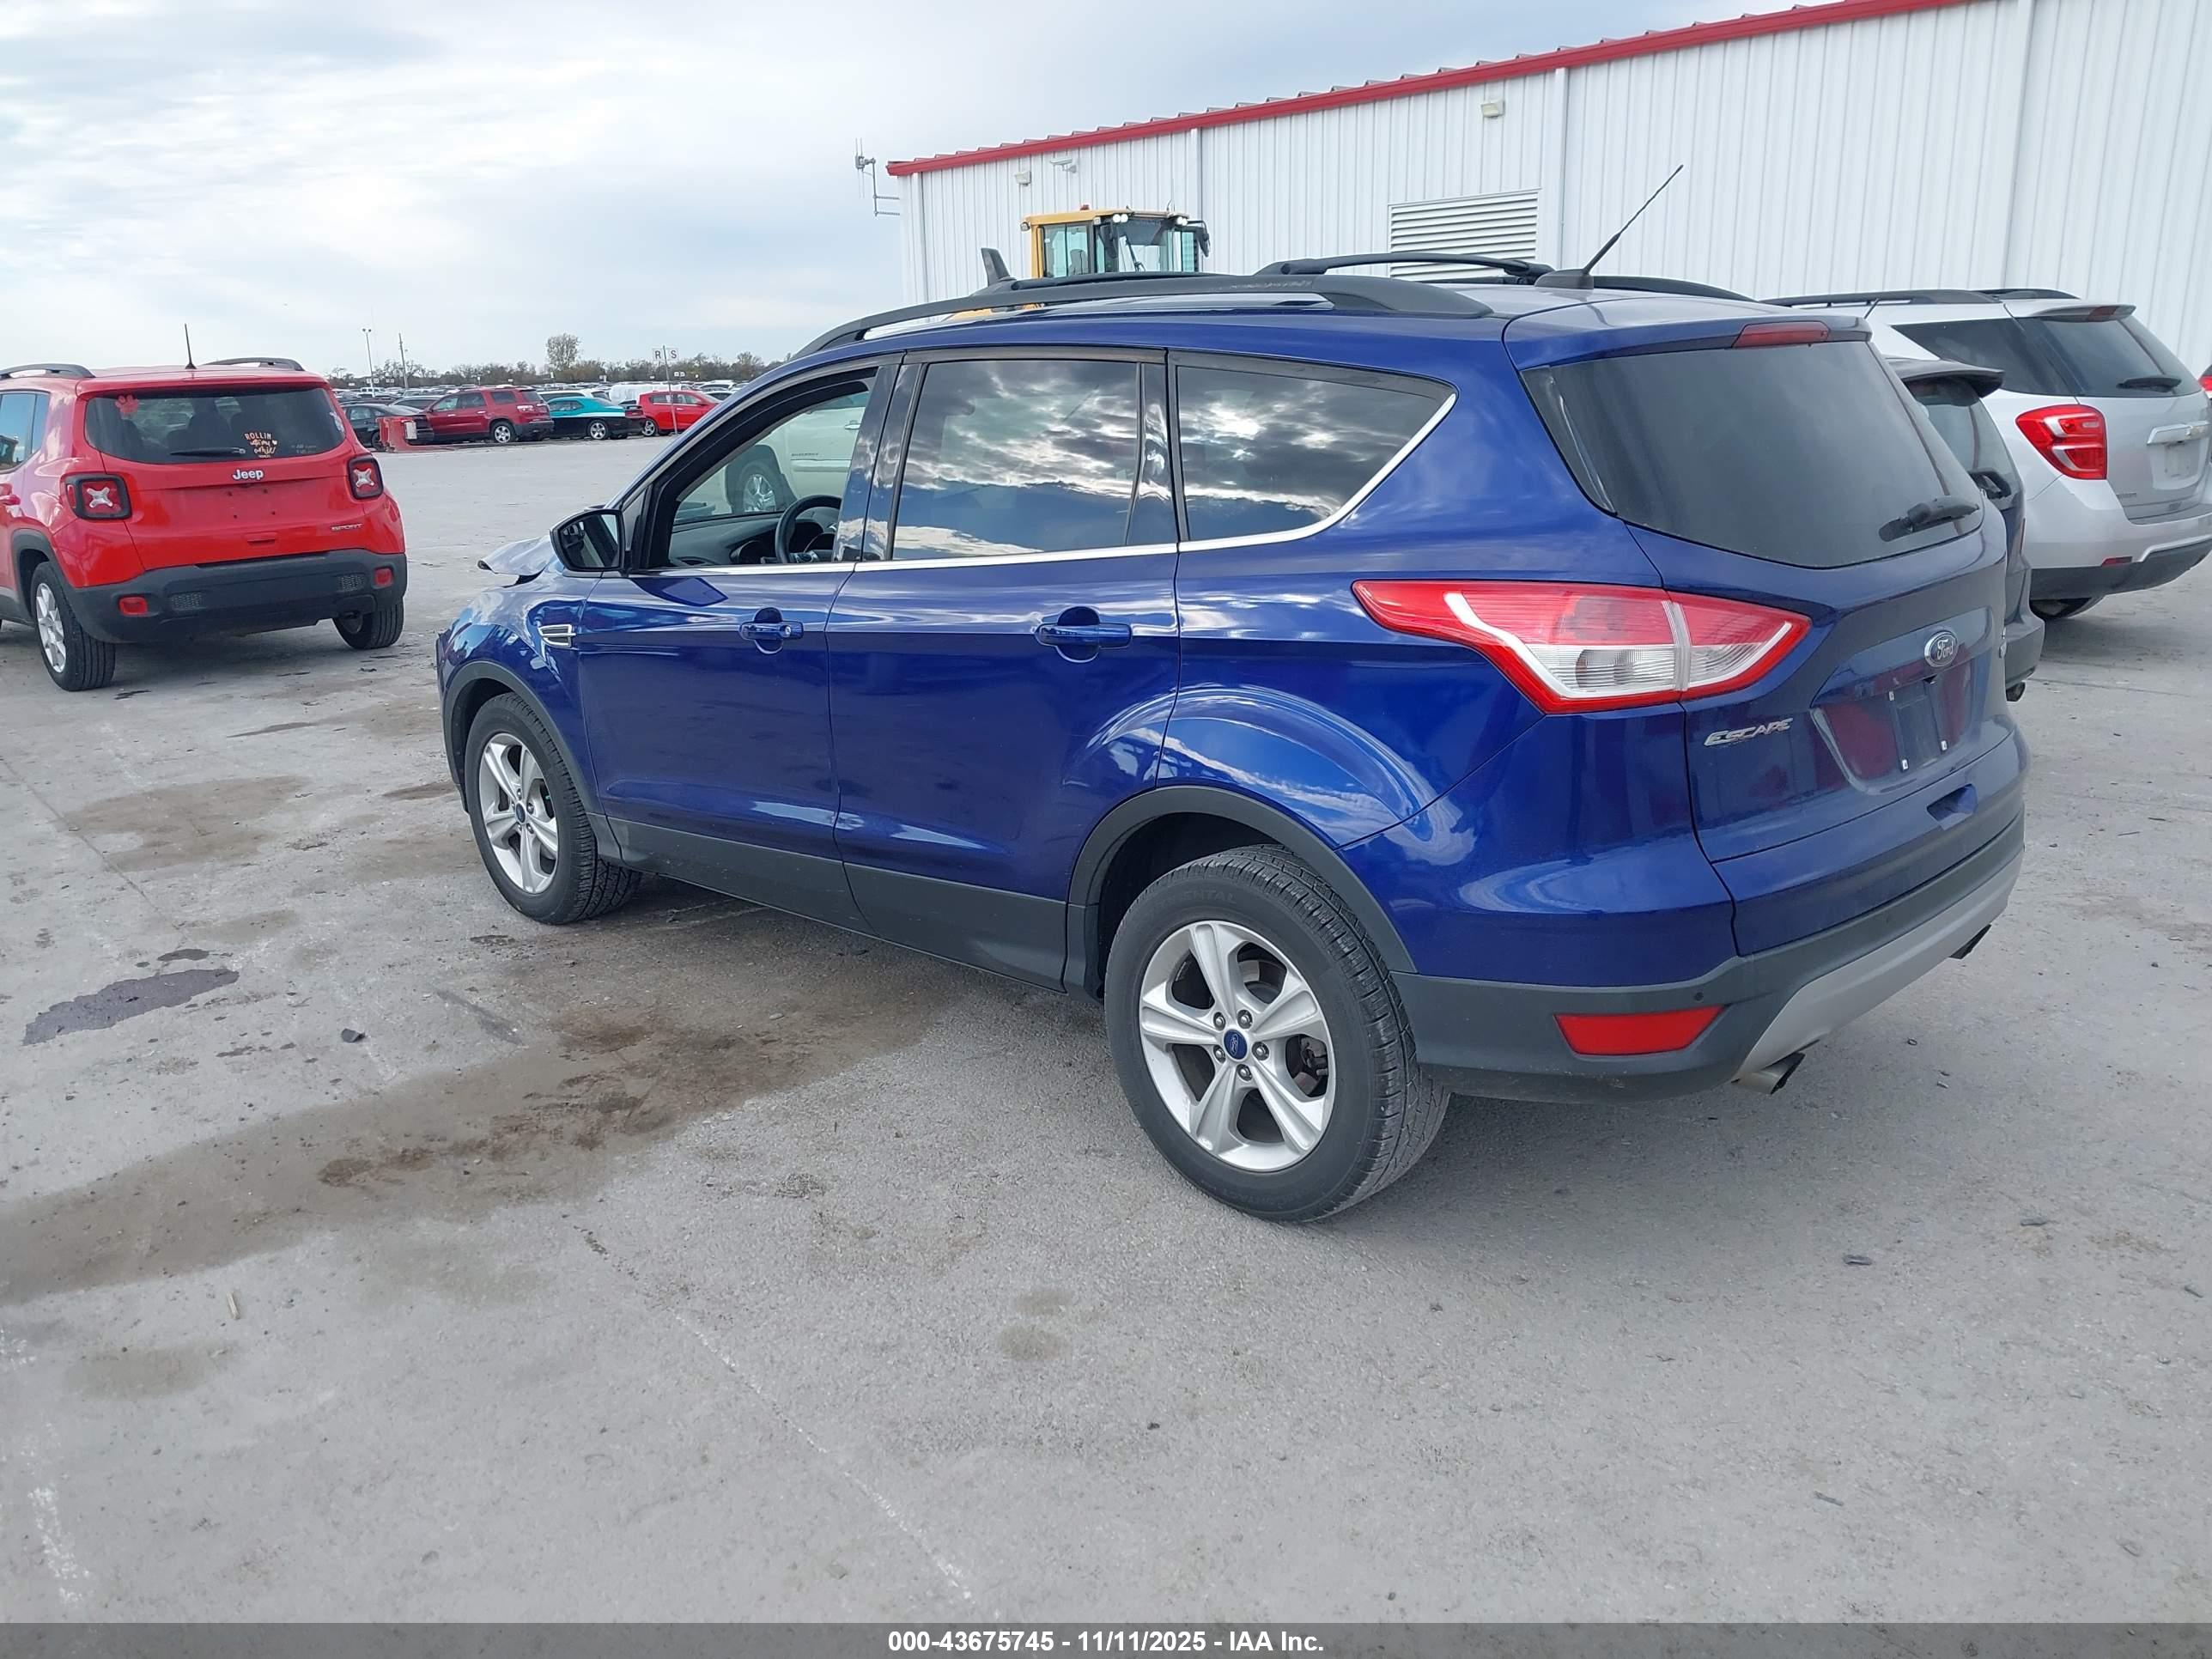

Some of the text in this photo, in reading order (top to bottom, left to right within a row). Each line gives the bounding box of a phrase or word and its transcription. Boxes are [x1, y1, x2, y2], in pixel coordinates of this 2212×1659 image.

[654, 349, 662, 360] R
[670, 349, 678, 359] S
[244, 432, 271, 441] ROLLIN
[232, 469, 264, 480] Jeep
[1936, 638, 1954, 660] Ford
[1704, 718, 1794, 746] ESCAPE
